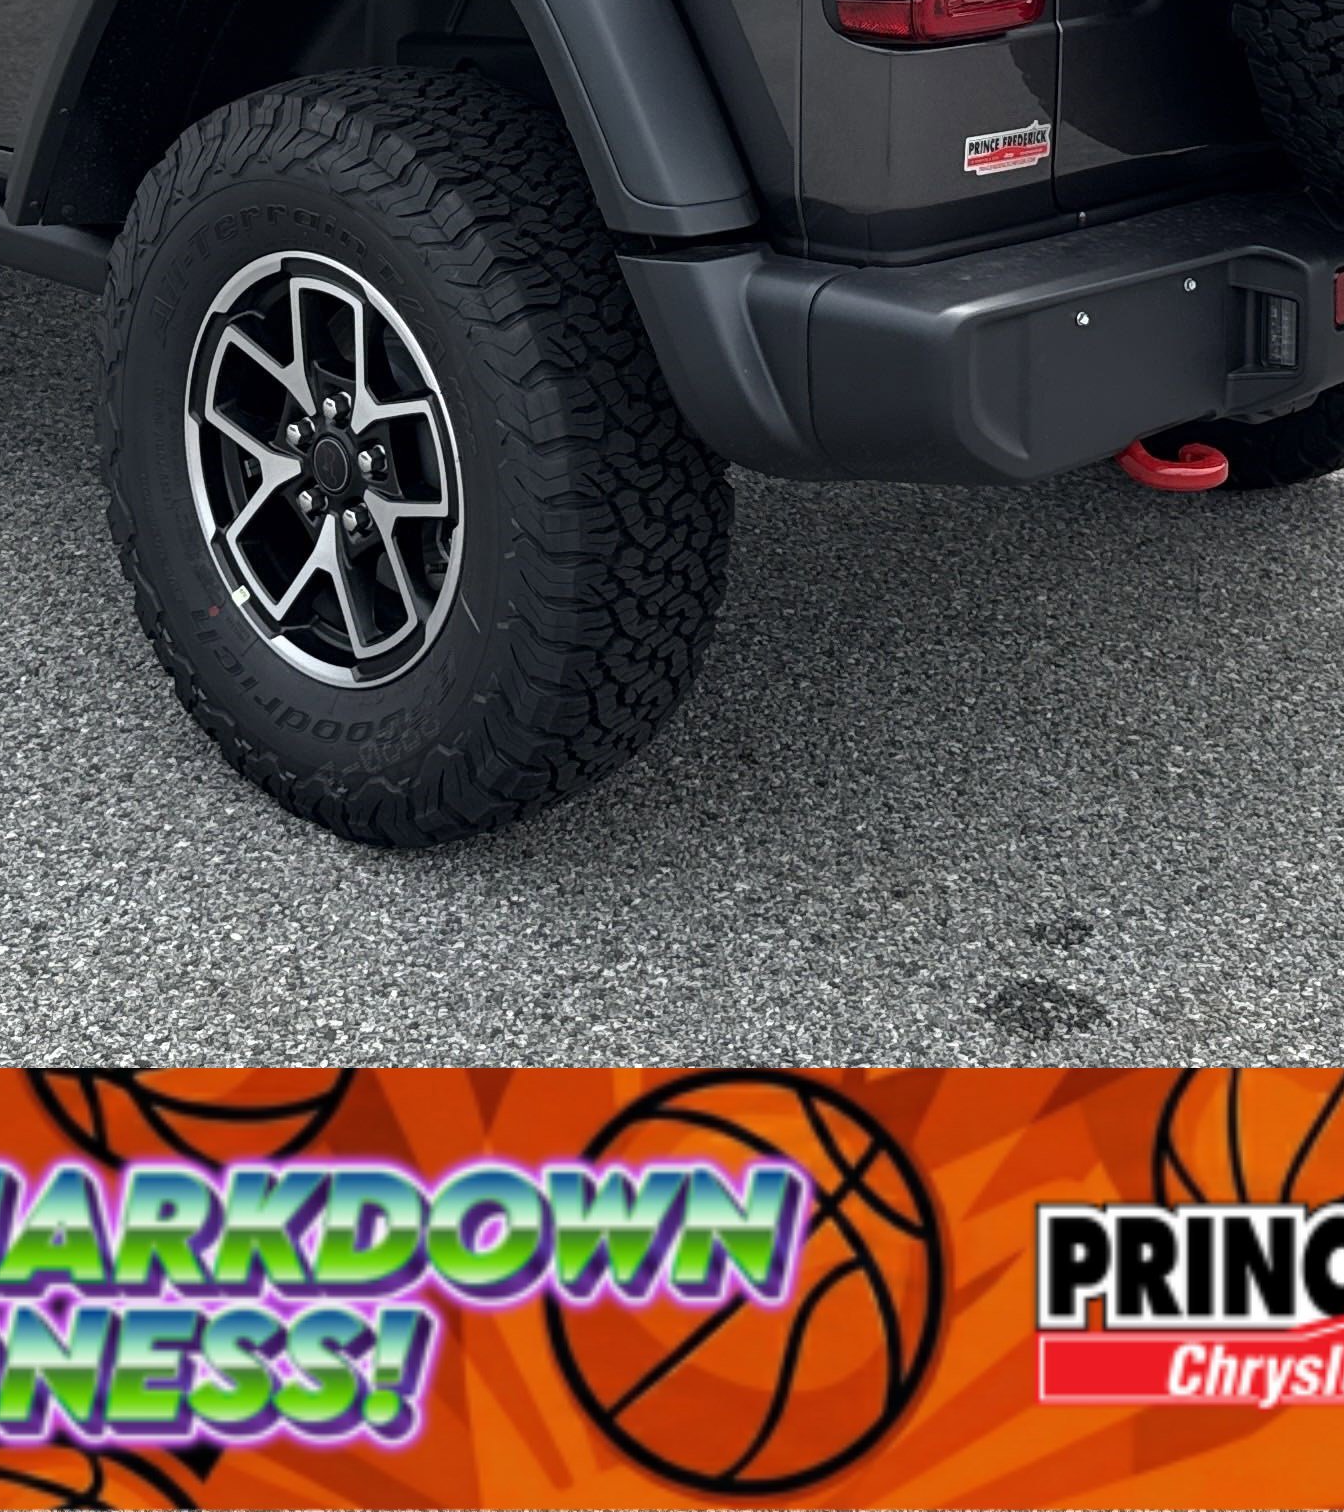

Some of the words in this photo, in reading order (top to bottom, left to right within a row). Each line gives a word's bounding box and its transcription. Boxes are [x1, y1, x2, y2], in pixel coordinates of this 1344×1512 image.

[968, 137, 1000, 156] PRINCE
[1002, 129, 1048, 148] FREDERICK
[153, 202, 368, 348] All-Terrain
